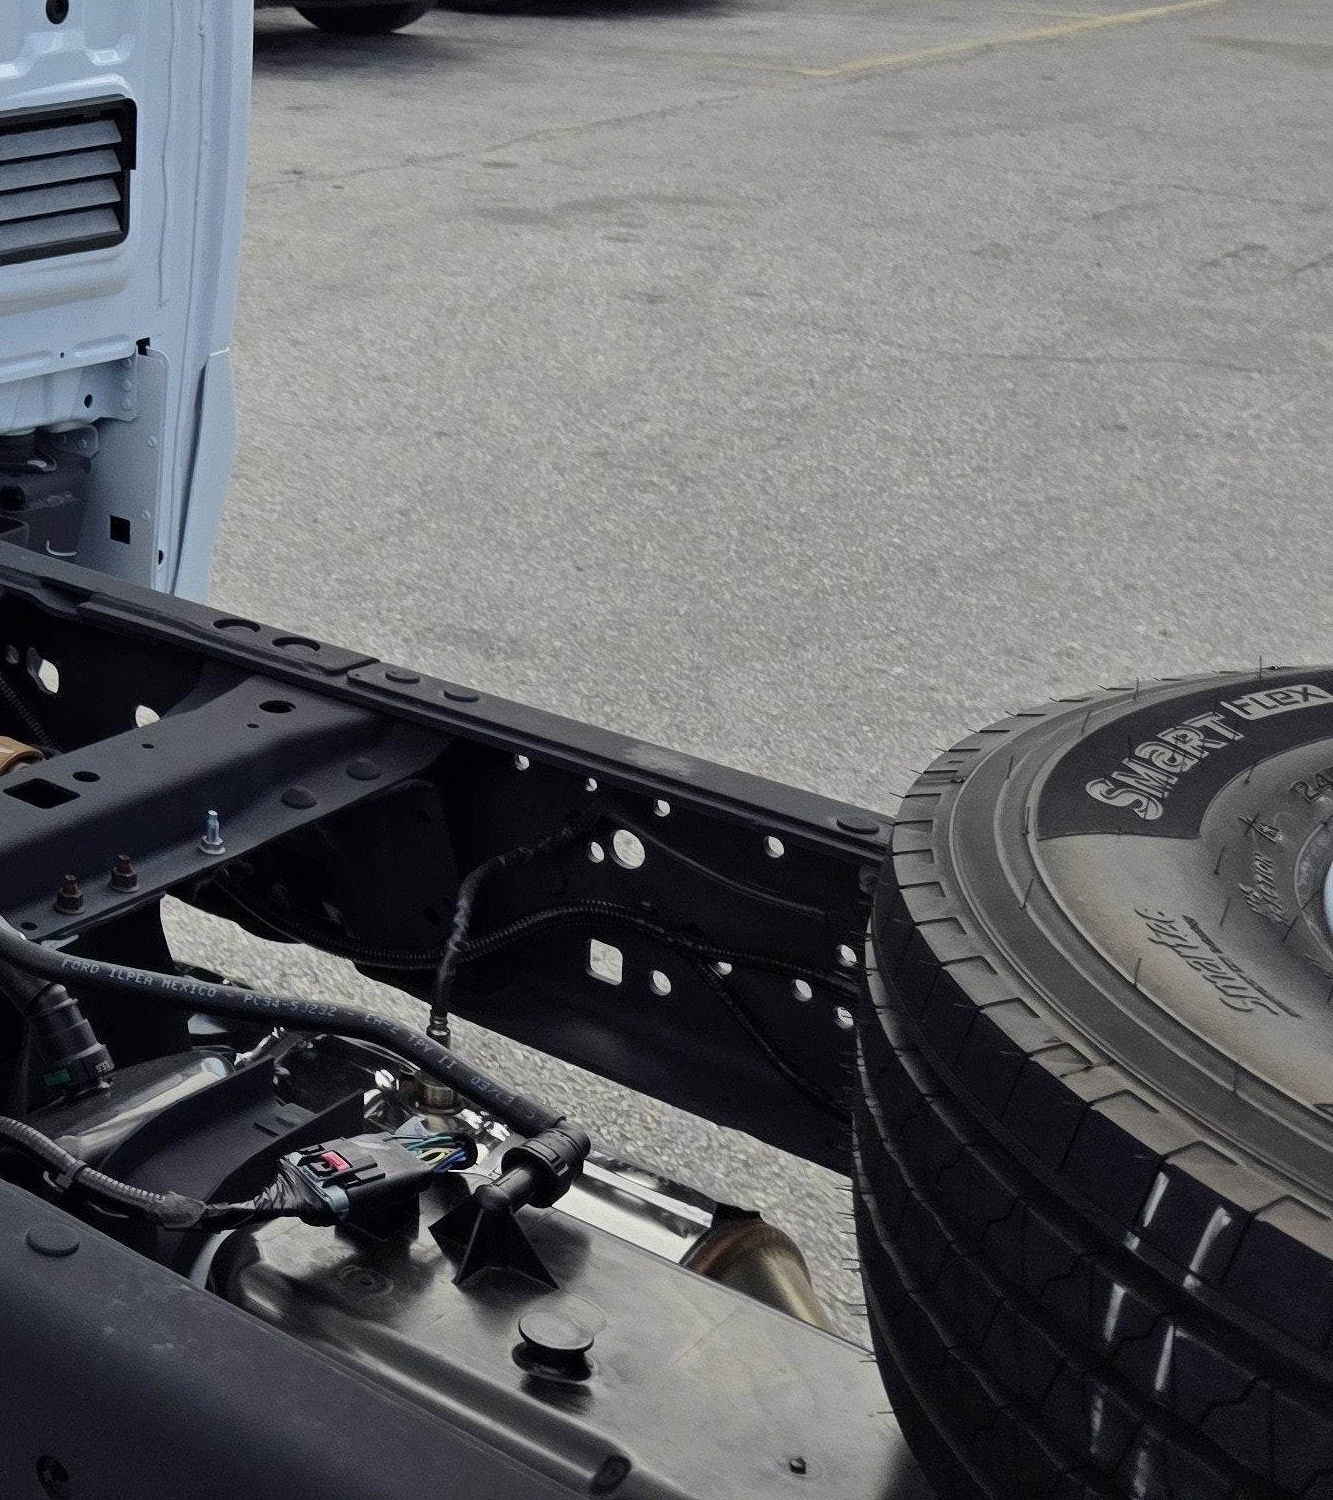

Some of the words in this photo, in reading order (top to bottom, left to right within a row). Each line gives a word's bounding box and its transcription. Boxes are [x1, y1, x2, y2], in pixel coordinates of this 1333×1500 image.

[61, 958, 101, 976] FORD
[108, 966, 153, 987] ILPEA
[162, 977, 218, 999] MEXICO
